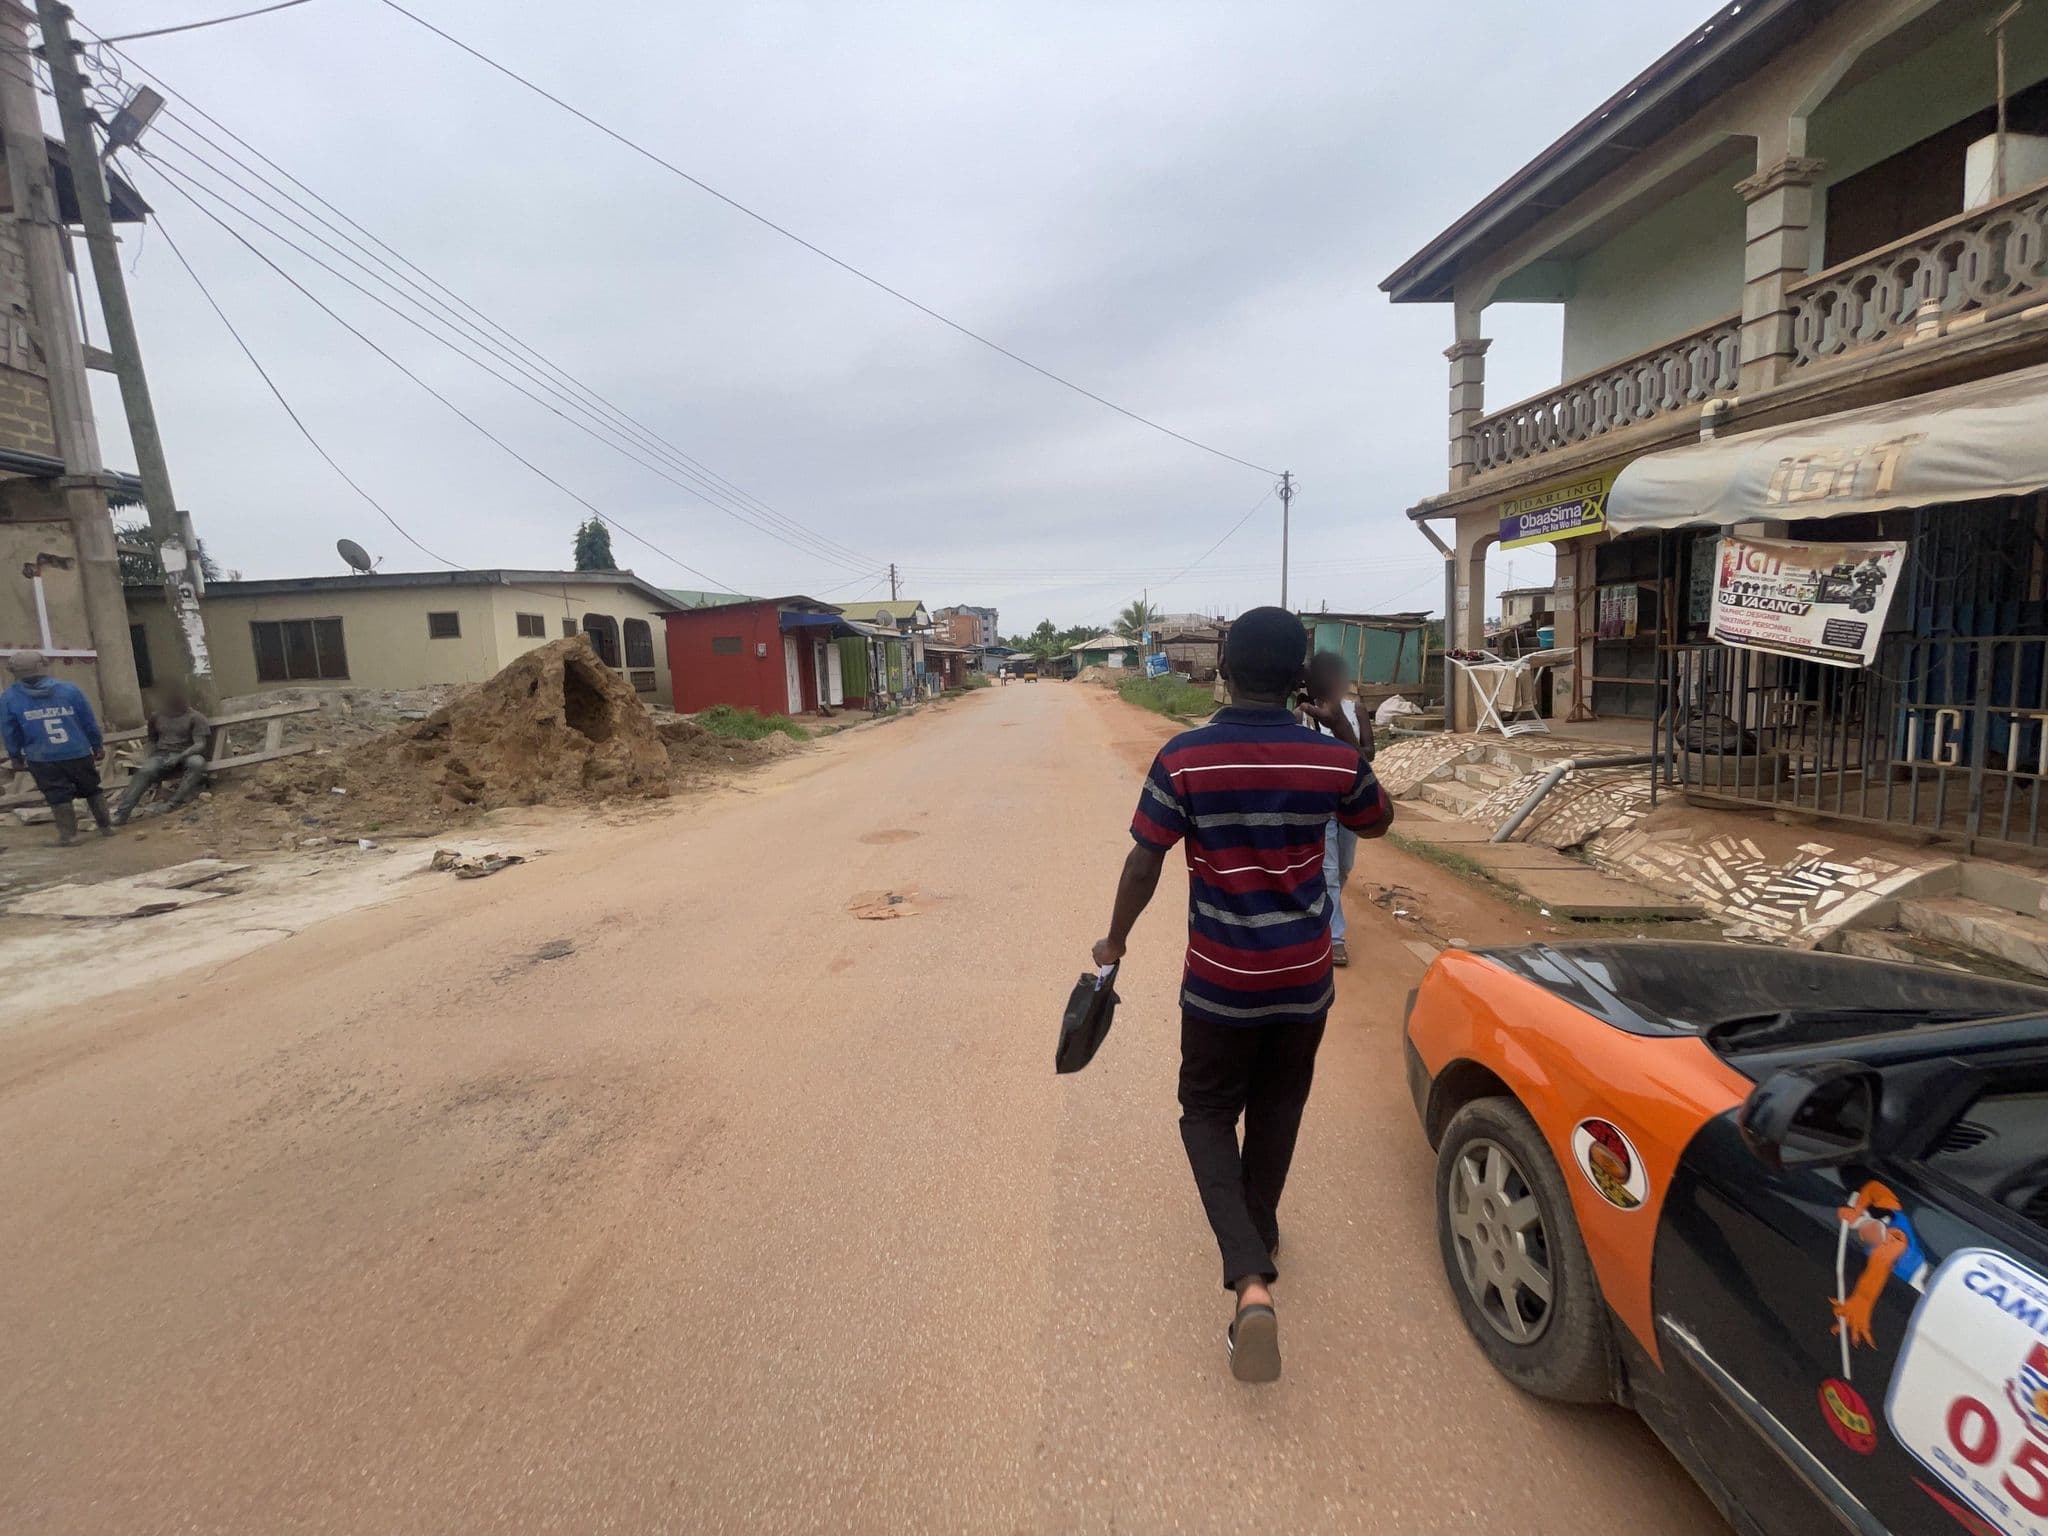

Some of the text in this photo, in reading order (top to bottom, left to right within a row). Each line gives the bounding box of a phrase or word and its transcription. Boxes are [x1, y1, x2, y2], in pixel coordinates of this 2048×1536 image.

[1524, 483, 1598, 508] DARLING
[1520, 504, 1581, 530] ObaaSima
[1719, 593, 1809, 615] OB VACANCY
[1746, 610, 1781, 621] DESIGNER
[1751, 620, 1793, 633] PERSONNEL
[1761, 631, 1789, 641] OFFICE
[1789, 636, 1813, 645] CLERK
[44, 718, 69, 744] 5
[1963, 1270, 2048, 1337] CAM
